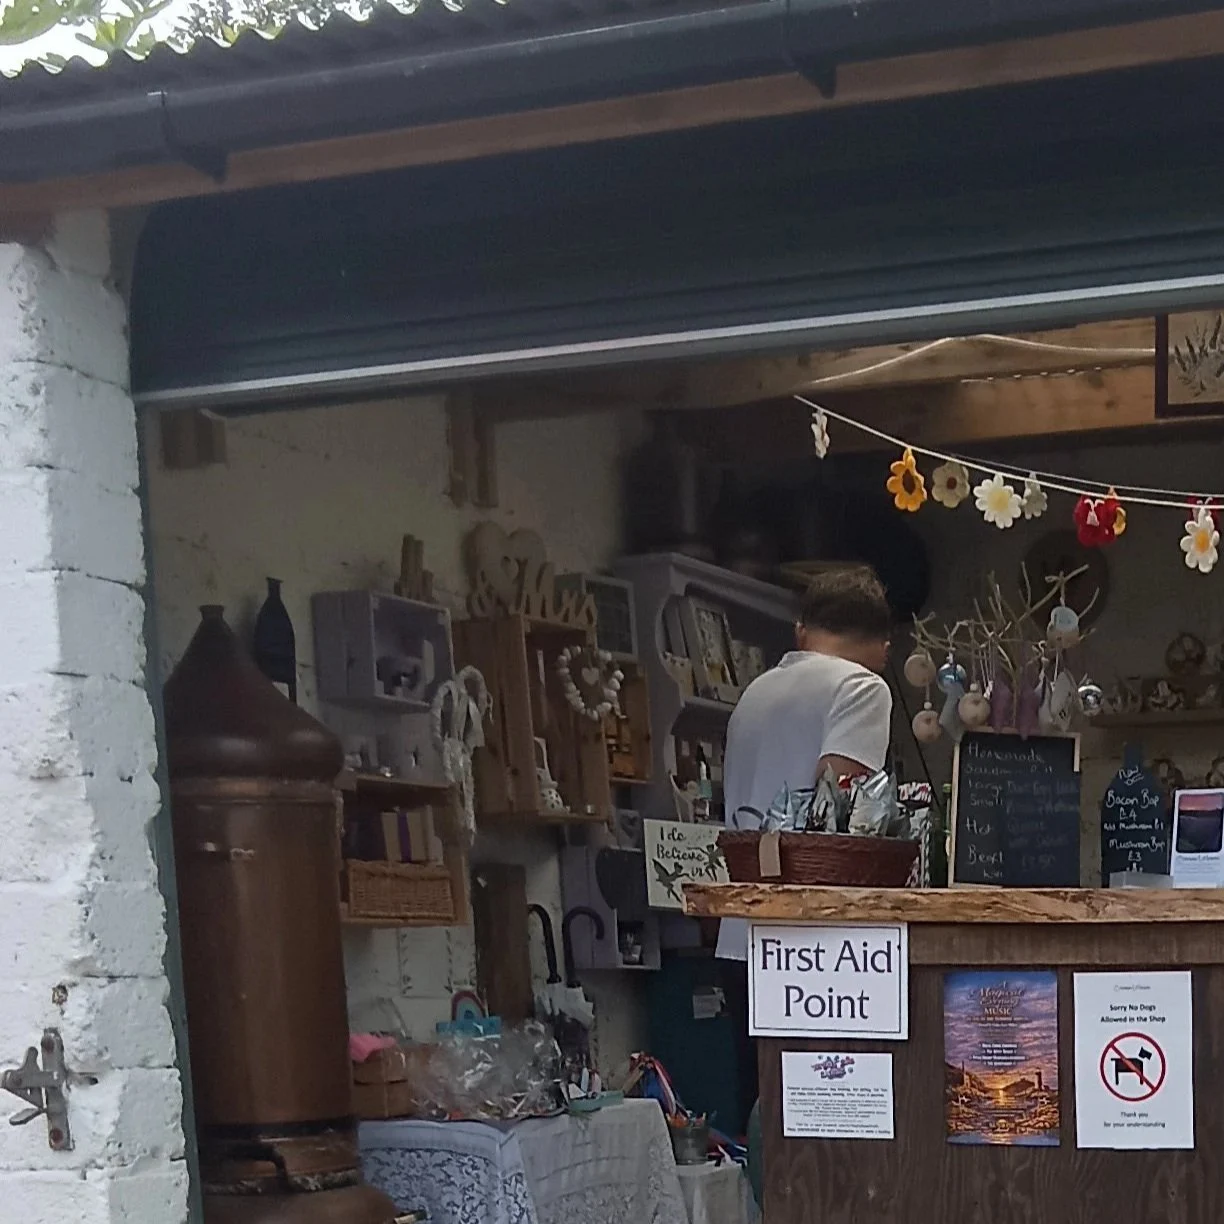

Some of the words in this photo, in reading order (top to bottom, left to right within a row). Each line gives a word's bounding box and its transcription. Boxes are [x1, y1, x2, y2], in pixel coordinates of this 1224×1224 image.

[1106, 790, 1138, 808] Bacon
[1141, 788, 1160, 809] Bap
[660, 826, 665, 840] I
[667, 827, 684, 841] do
[656, 843, 705, 860] Believe
[761, 938, 826, 972] First
[834, 940, 892, 973] Aid
[784, 985, 869, 1019] Point
[1110, 1004, 1127, 1012] Sorry
[1140, 1004, 1156, 1012] Dogs
[984, 1007, 1011, 1015] MUSIC
[1150, 1015, 1166, 1023] Shop
[1127, 1121, 1166, 1129] understanding
